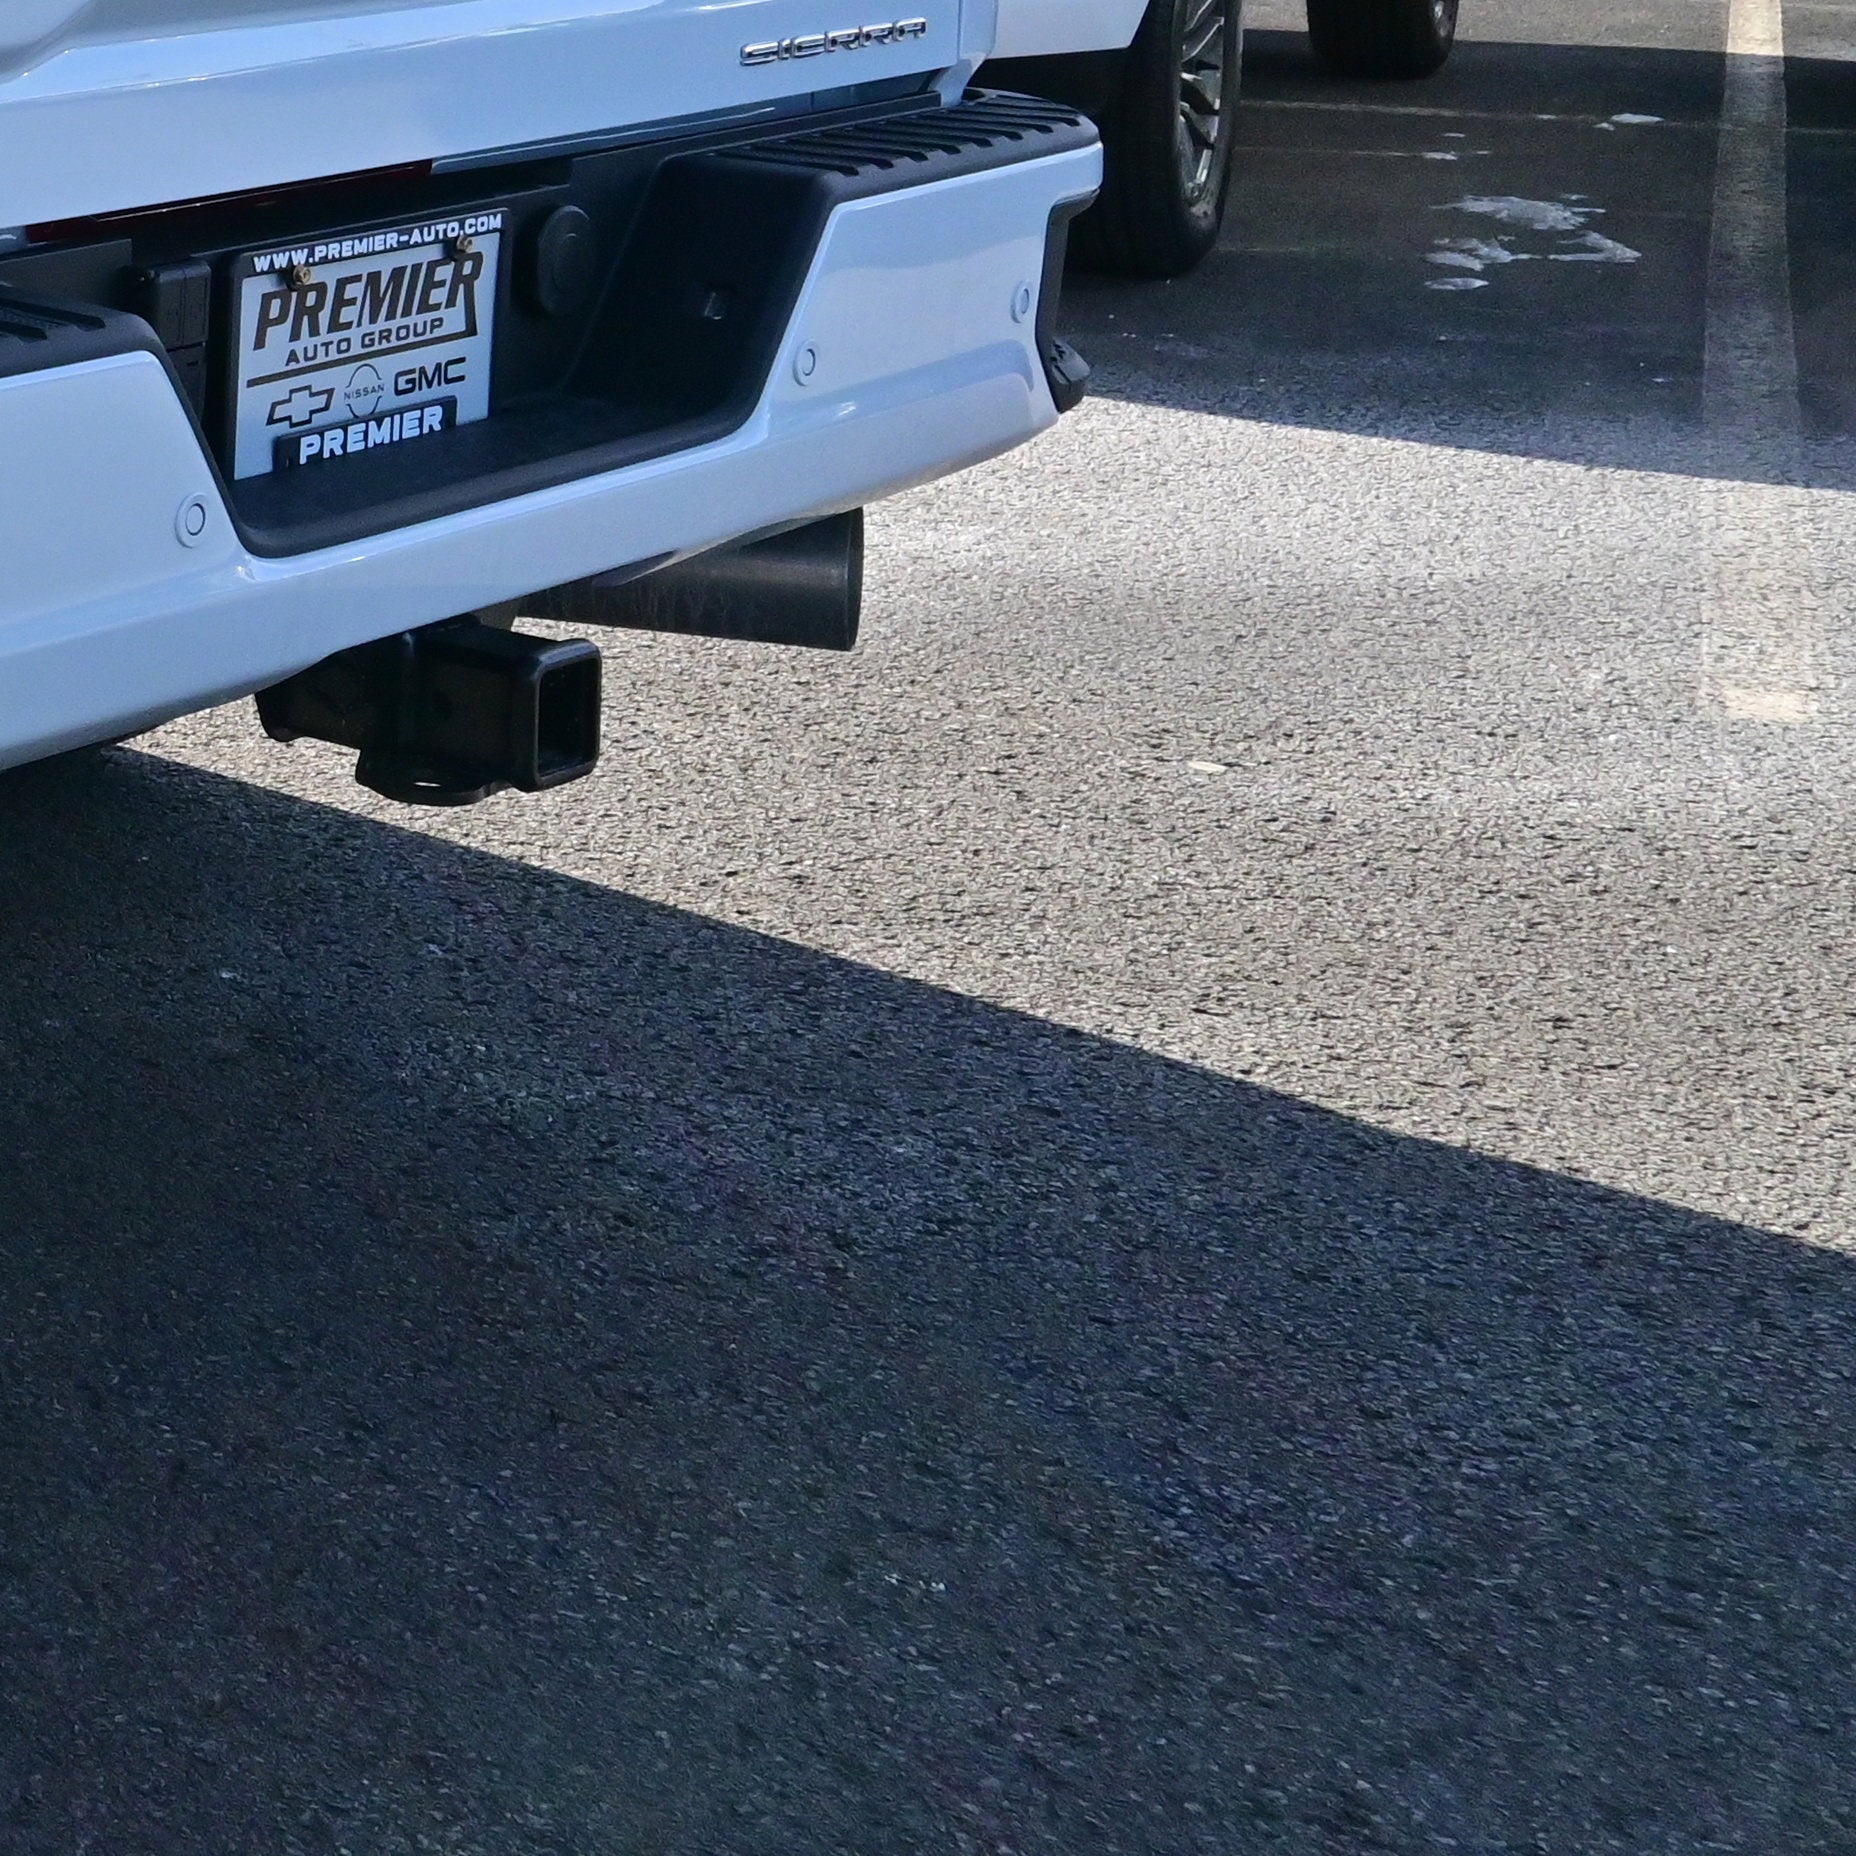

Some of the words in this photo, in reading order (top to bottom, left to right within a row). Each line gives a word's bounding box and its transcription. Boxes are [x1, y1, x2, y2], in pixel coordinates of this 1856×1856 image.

[740, 17, 928, 66] SIERRA
[252, 213, 503, 273] WWW.PREMIER-AUTO.COM
[253, 250, 484, 351] PREMIER
[285, 337, 351, 367] AUTO
[360, 316, 444, 350] GROUP
[344, 383, 386, 401] NISSAN
[393, 356, 467, 397] GMC
[298, 404, 444, 466] PREMIER
